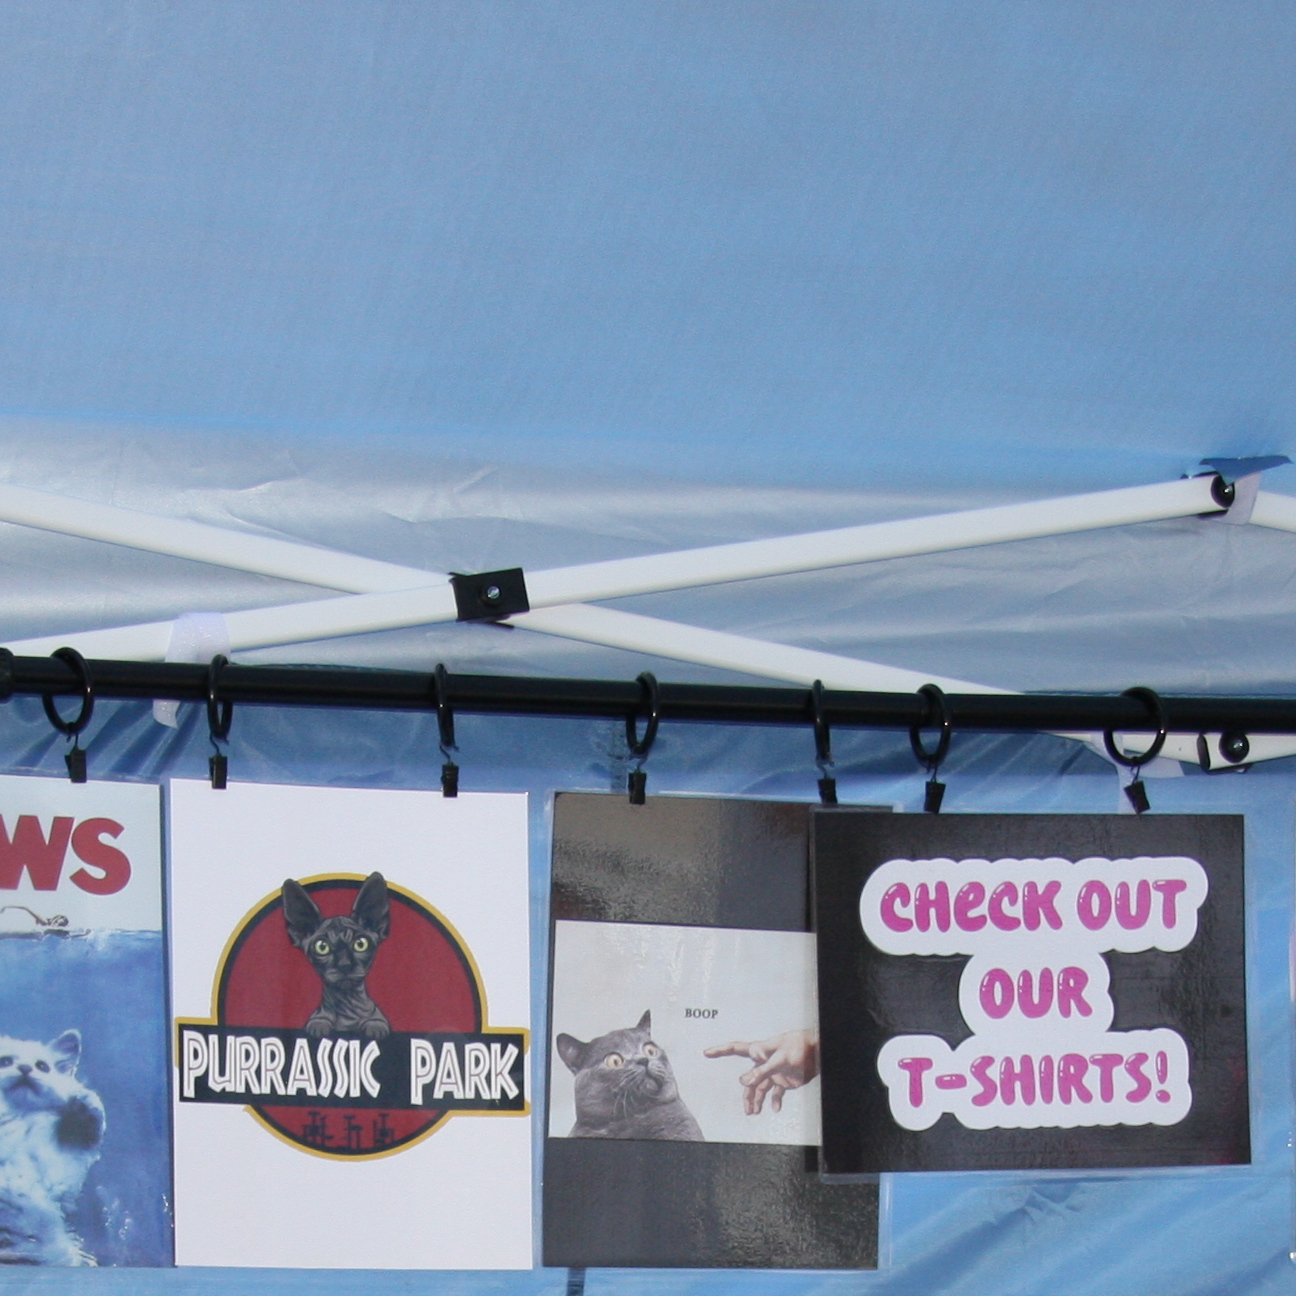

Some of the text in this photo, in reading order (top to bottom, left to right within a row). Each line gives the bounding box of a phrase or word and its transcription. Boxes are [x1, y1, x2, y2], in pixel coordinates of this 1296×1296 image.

[1076, 878, 1187, 931] OUT
[684, 1008, 718, 1020] BOOP
[978, 965, 1093, 1020] OUR
[182, 1030, 519, 1106] PURRASSIC PARK
[897, 1050, 1168, 1108] T-SHIRTS!
